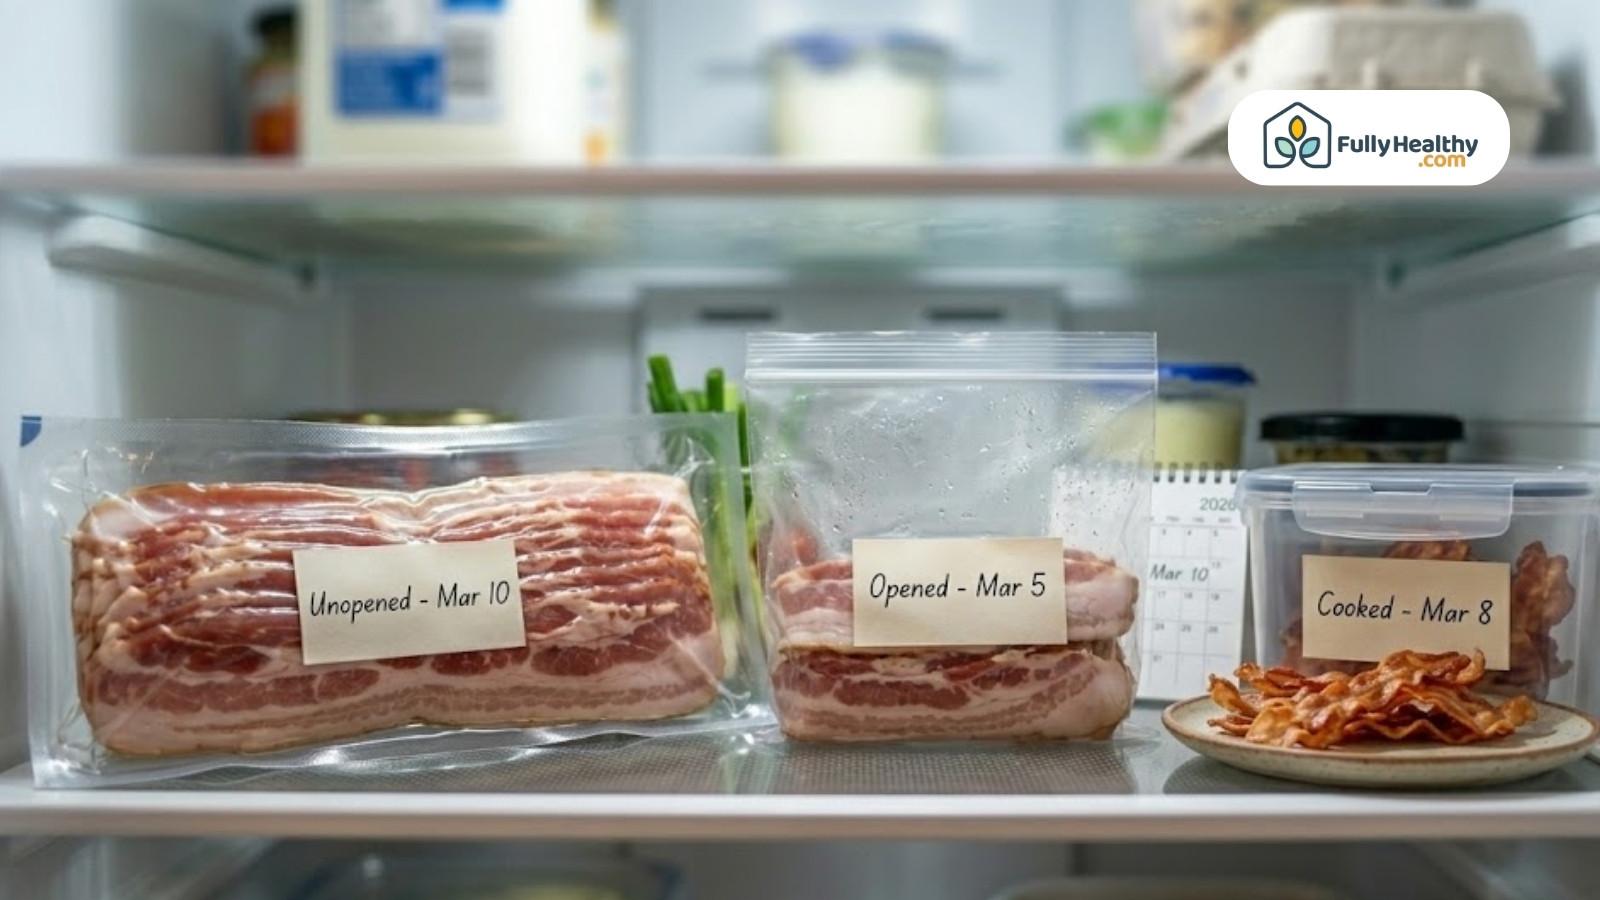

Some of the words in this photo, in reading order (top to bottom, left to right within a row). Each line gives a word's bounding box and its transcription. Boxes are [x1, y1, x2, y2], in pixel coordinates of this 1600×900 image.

[1200, 497, 1237, 511] 2026
[870, 572, 950, 608] Opened
[976, 572, 1022, 597] Mar
[1030, 572, 1046, 597] 5
[1150, 563, 1182, 581] Mar
[1191, 567, 1209, 582] 10
[310, 585, 412, 624] Unopened
[437, 582, 480, 608] Mar
[489, 580, 510, 605] 10
[1317, 590, 1395, 619] Cooked
[1421, 596, 1470, 622] Mar
[1478, 600, 1493, 625] 8
